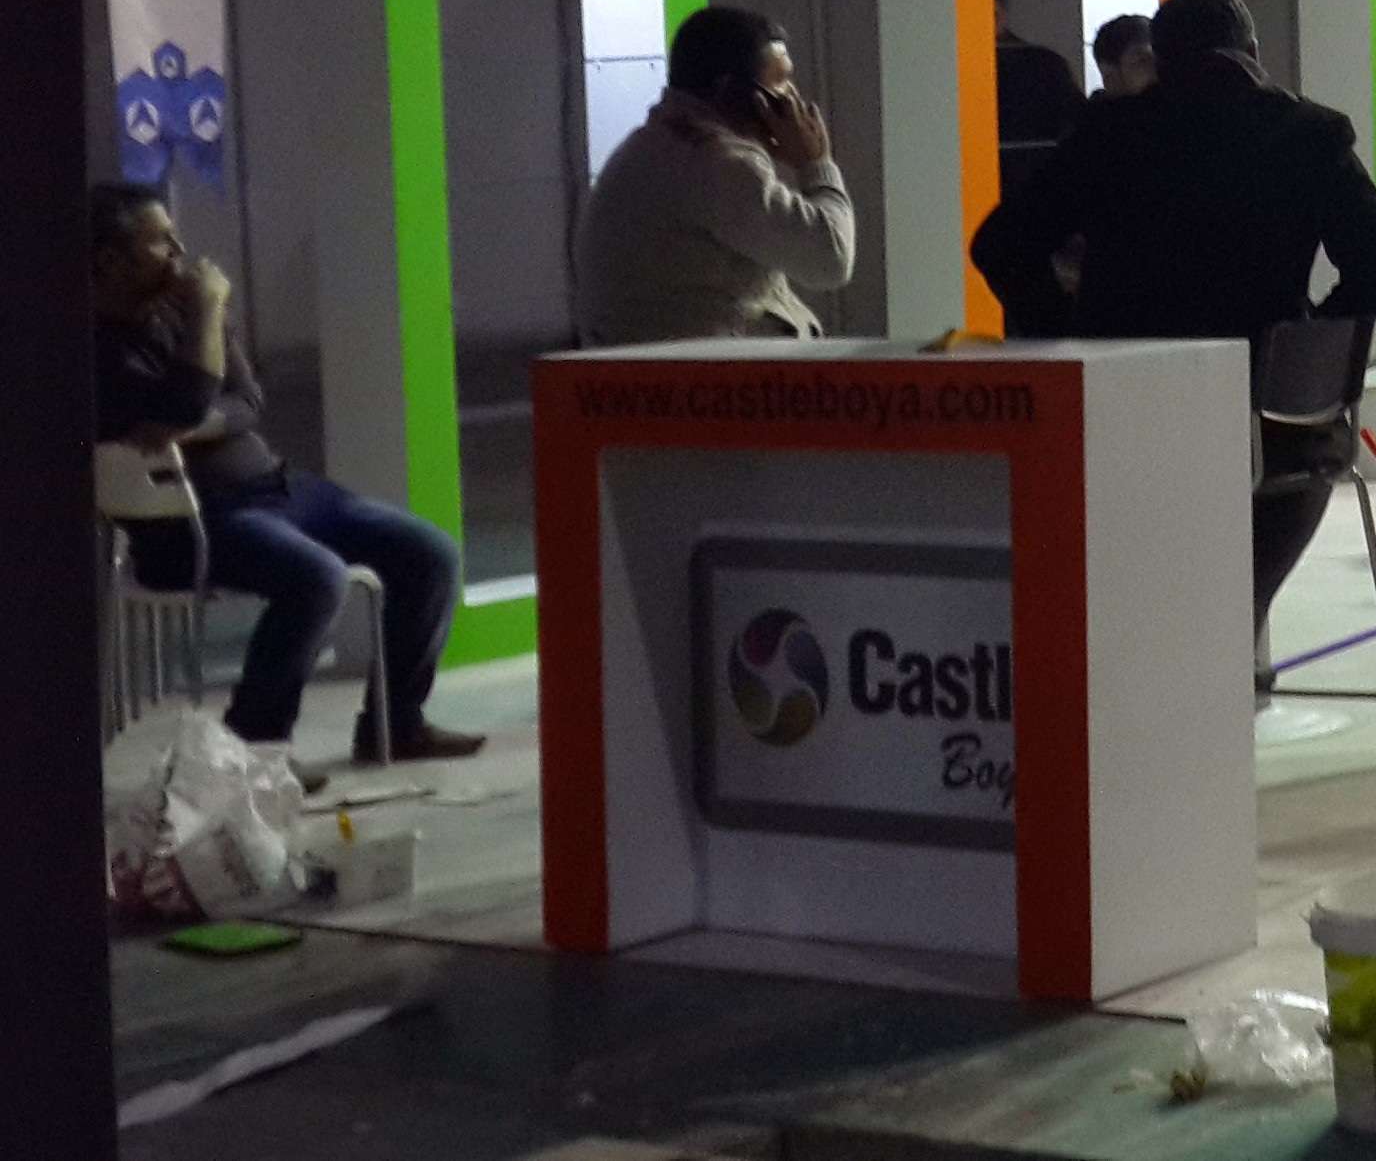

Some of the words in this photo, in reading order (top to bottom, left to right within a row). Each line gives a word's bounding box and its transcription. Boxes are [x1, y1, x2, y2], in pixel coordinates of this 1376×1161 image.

[577, 373, 1035, 427] www.castleboya.com
[849, 628, 1012, 720] Castl
[940, 731, 1016, 810] Boy
